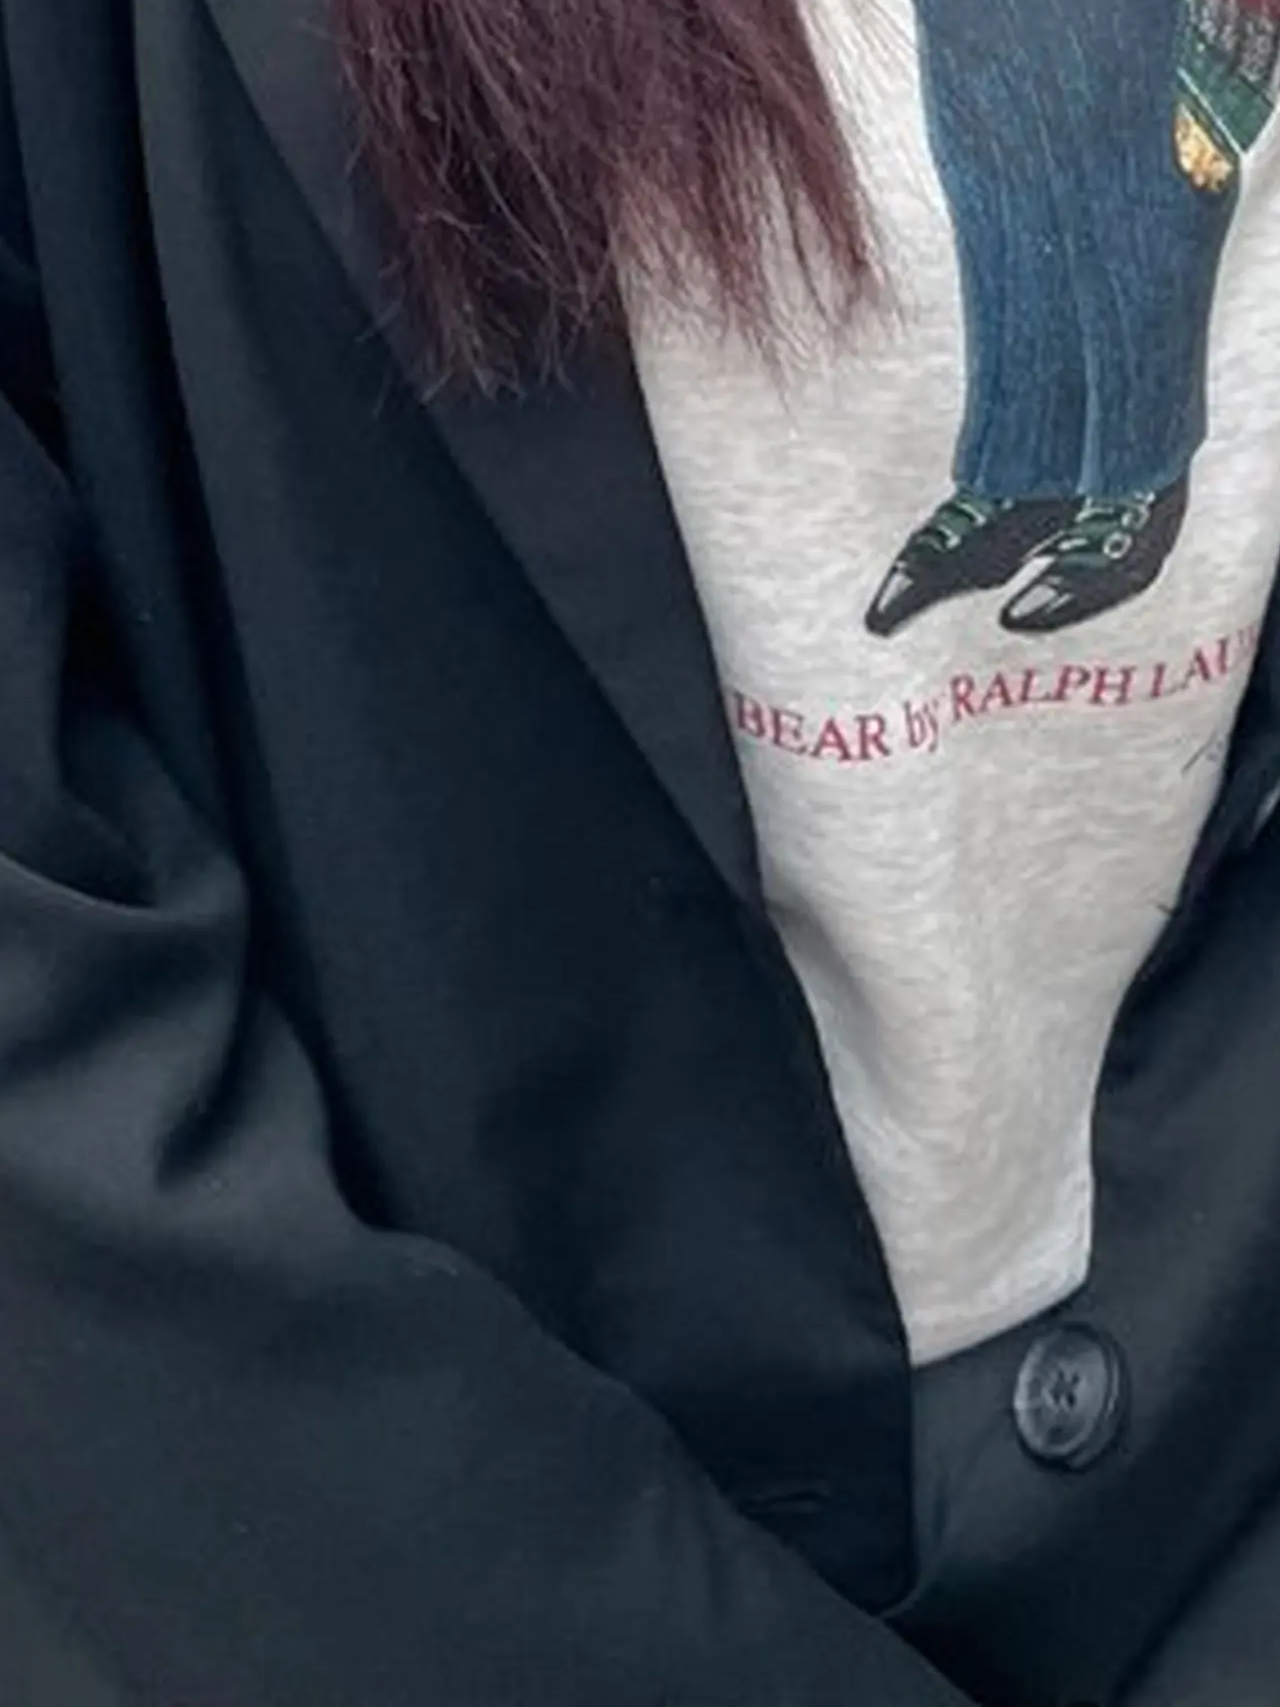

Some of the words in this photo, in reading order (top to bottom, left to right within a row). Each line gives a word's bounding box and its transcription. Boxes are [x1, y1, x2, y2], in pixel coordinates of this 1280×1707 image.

[733, 691, 892, 761] BEAR
[904, 699, 941, 754] by
[949, 663, 1138, 721] RALPH
